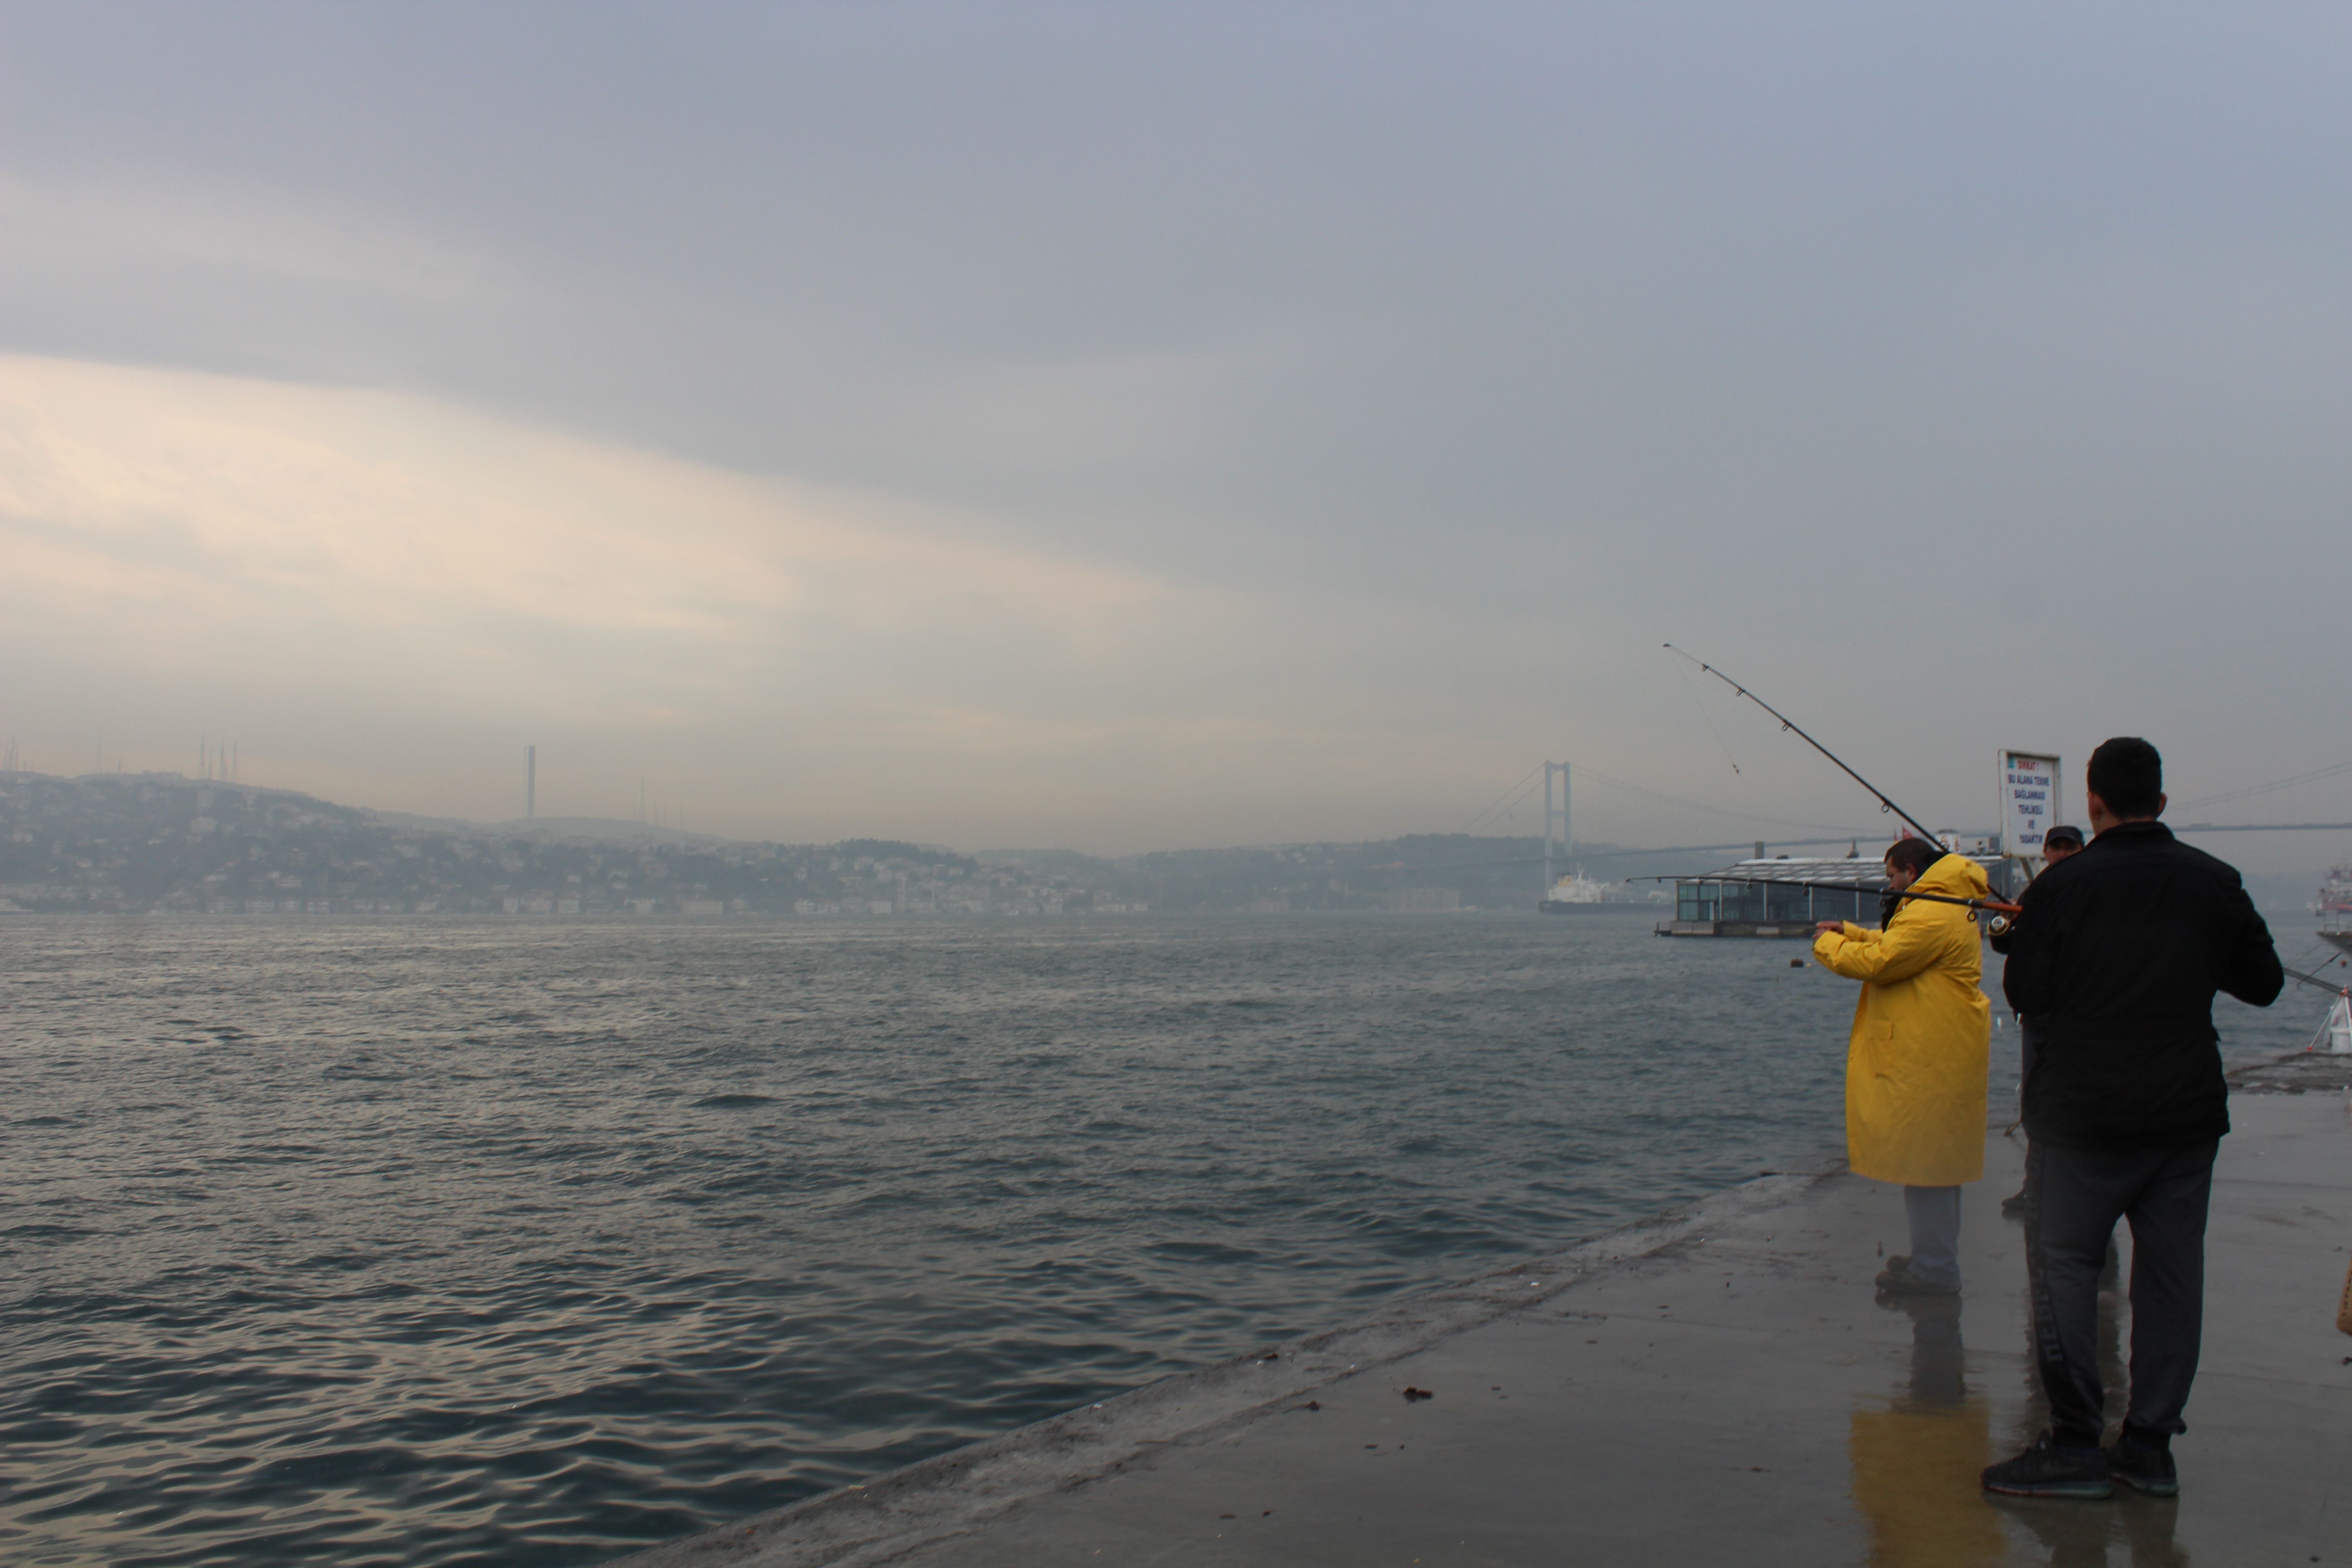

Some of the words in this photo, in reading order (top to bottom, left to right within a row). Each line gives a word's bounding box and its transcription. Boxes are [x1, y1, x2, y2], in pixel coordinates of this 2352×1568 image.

[2008, 774, 2016, 784] BU
[2017, 774, 2033, 784] ALANA
[2034, 776, 2049, 786] TEKNE
[2028, 819, 2035, 829] VE
